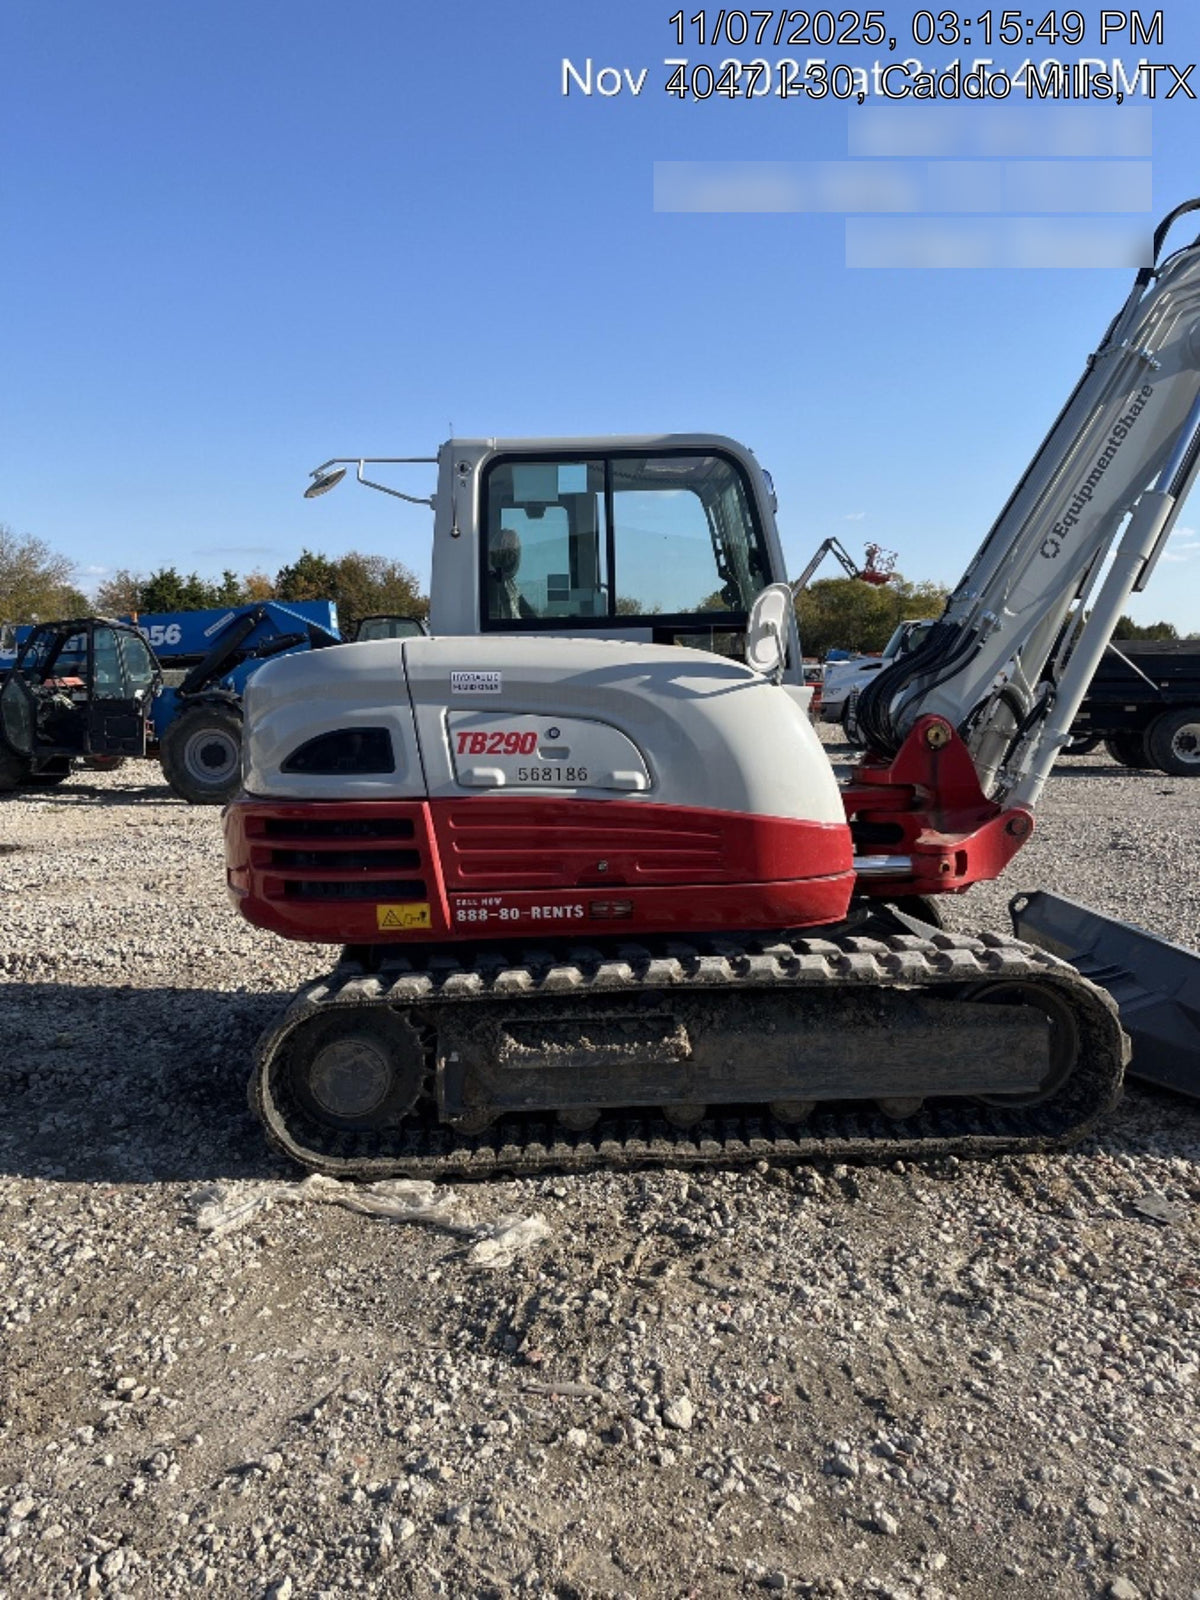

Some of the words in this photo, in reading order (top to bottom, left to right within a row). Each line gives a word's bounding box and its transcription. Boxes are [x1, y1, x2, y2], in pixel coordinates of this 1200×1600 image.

[1051, 384, 1153, 540] EquipmentShare
[456, 731, 538, 755] TB290
[518, 767, 588, 782] 568186
[456, 904, 584, 921] 888-80-RENTS
